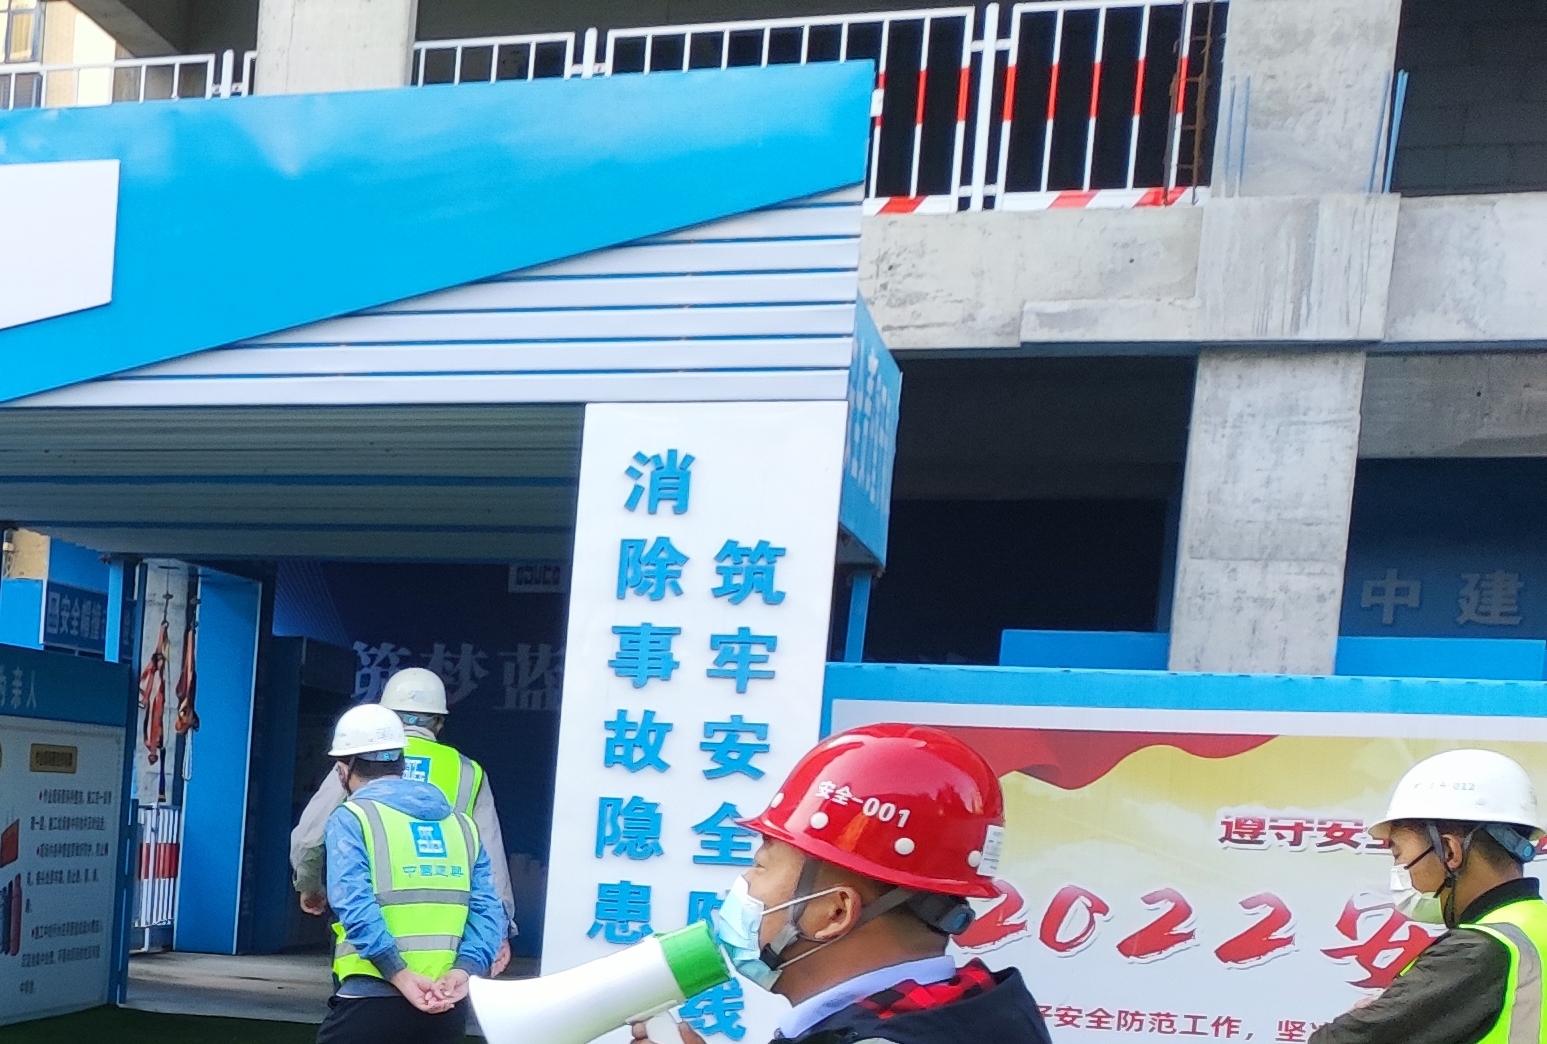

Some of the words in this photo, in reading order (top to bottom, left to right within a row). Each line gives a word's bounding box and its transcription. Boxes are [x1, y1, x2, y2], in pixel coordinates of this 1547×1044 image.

[586, 448, 697, 945] 消除事故隐患
[1037, 1005, 1319, 1042] 安全防范工作，坚
